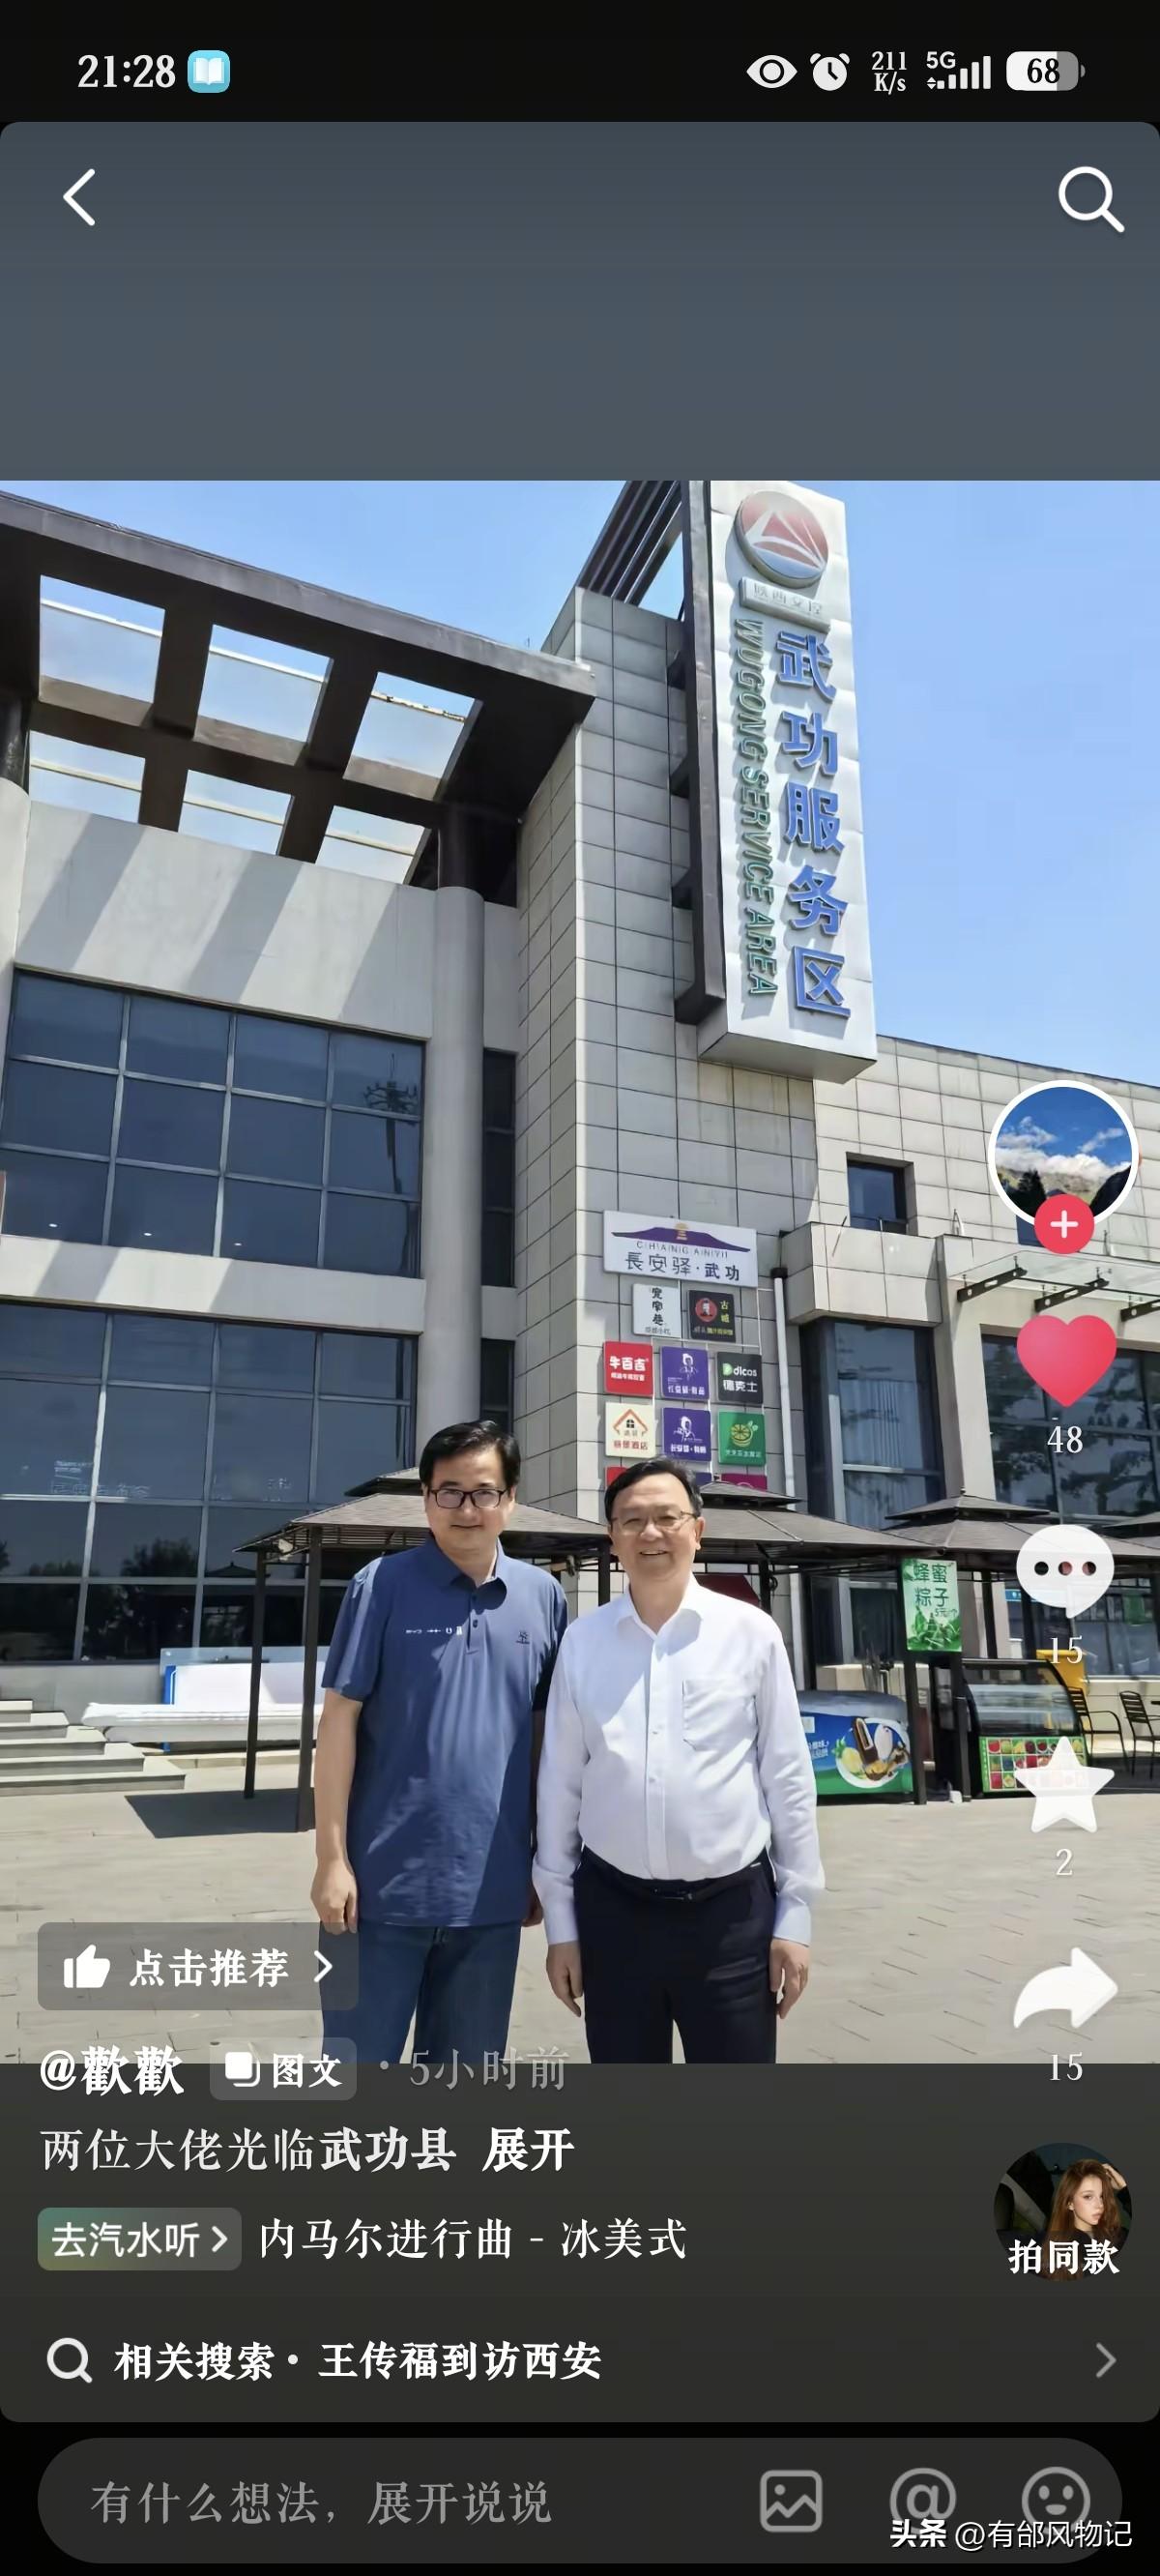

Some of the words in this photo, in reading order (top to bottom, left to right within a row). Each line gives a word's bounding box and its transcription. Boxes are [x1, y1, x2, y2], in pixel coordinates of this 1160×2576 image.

[735, 619, 768, 762] WUGONG
[740, 765, 774, 905] SERVICE
[776, 630, 851, 1016] 武功服务区
[744, 907, 778, 995] AREA
[914, 1563, 947, 1583] 蜂蜜
[914, 1587, 949, 1607] 粽子
